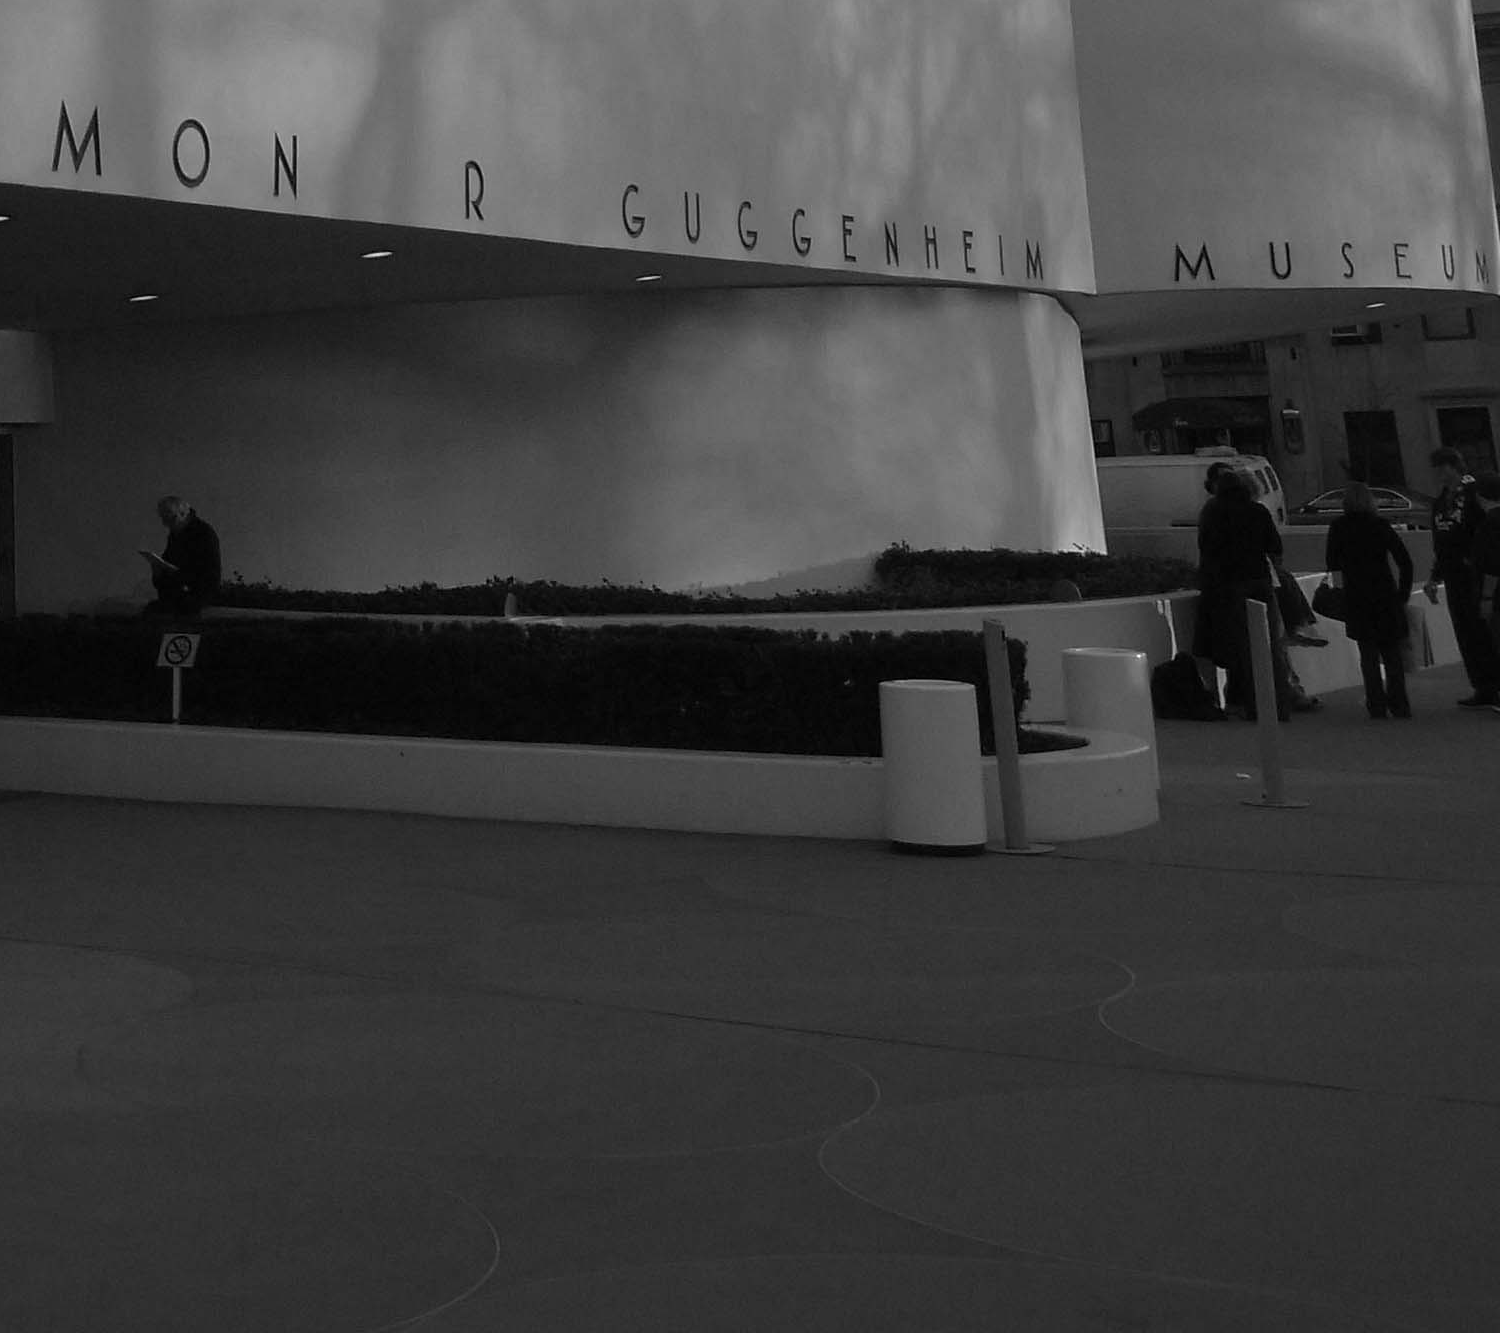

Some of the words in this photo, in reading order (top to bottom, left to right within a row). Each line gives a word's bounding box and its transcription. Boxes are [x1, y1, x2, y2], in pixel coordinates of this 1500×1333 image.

[464, 160, 485, 221] R
[621, 184, 1044, 280] GUGGENHEIM
[1174, 241, 1490, 285] MUSEUM
